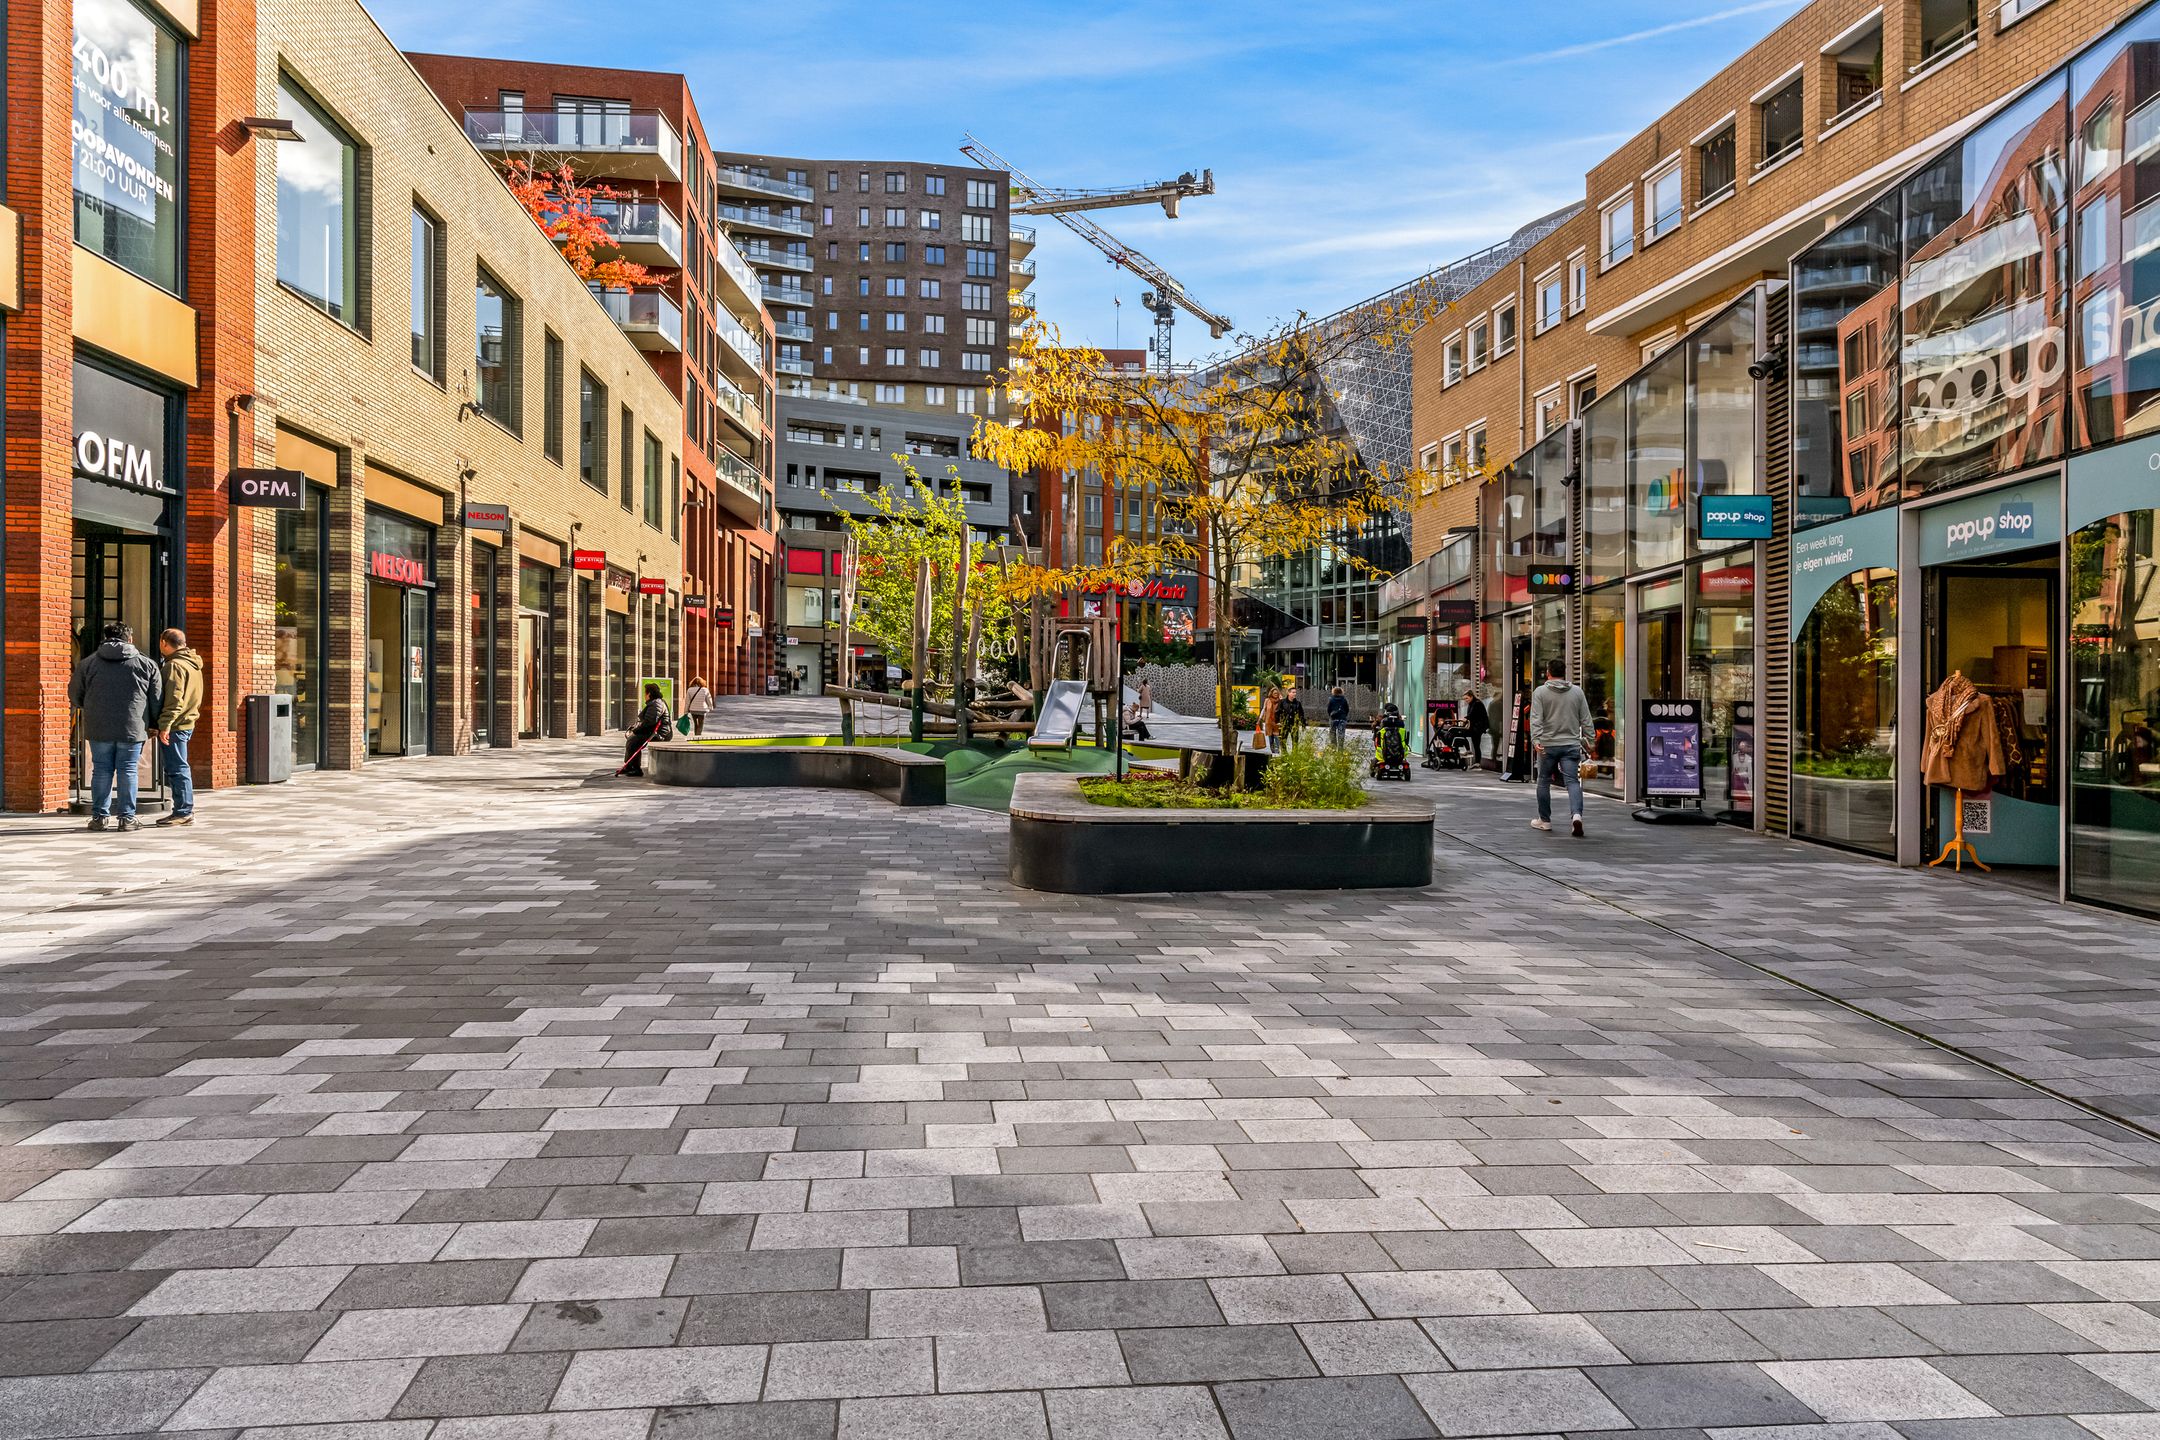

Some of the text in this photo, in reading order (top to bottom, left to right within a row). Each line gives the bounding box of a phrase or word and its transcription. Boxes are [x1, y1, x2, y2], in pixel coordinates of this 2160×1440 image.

[87, 86, 111, 110] voor
[113, 105, 131, 125] alle
[133, 119, 174, 157] mannen.
[80, 149, 115, 184] 21:00
[119, 171, 147, 206] UUR
[467, 511, 505, 521] NELSON
[1743, 512, 1766, 523] shop
[1999, 510, 2032, 534] shop
[1796, 534, 1844, 554] Een week lang
[371, 550, 425, 586] NELSON
[1795, 548, 1853, 575] je eigen winkel?
[1141, 579, 1188, 600] Markt
